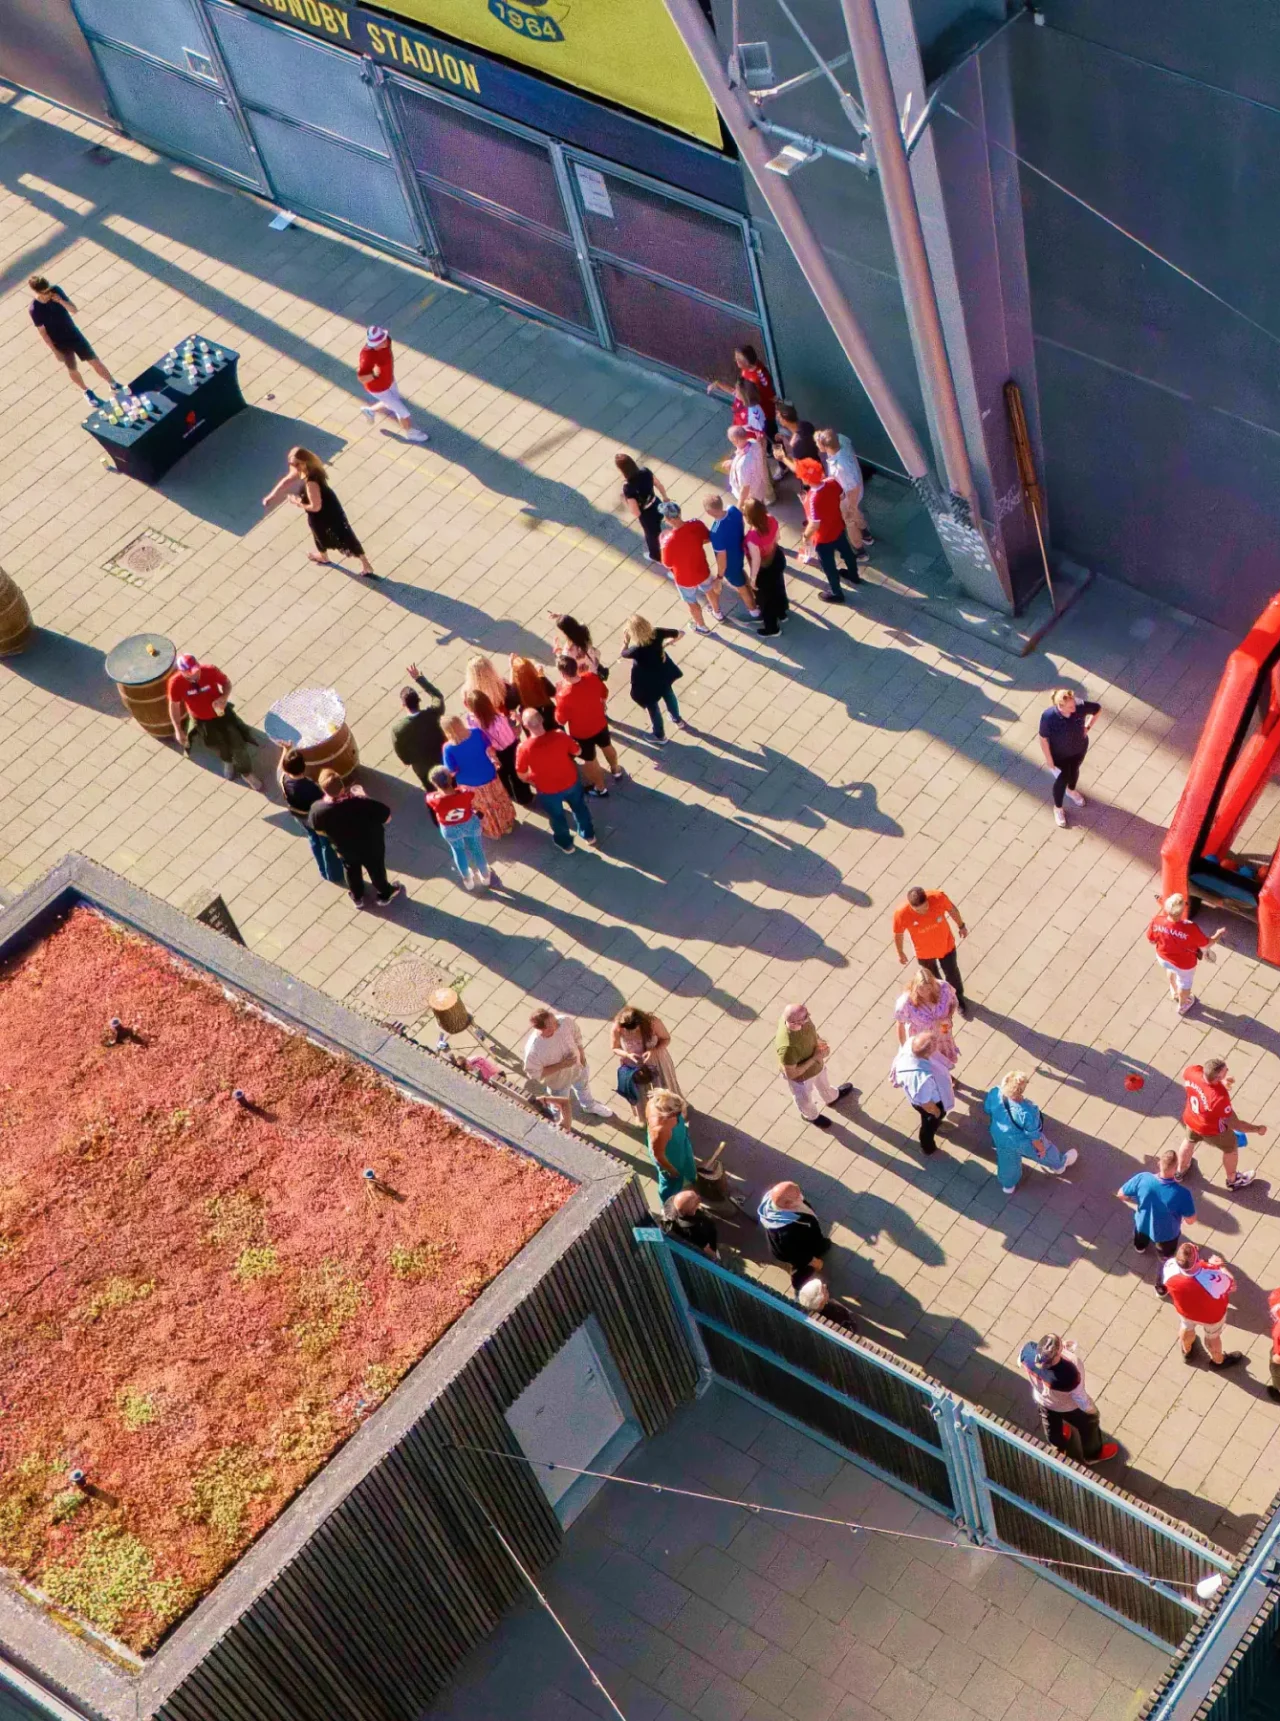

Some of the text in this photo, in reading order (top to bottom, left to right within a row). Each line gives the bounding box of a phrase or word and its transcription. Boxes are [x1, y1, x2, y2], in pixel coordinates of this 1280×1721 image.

[258, 0, 481, 94] NDBY STADION
[495, 2, 556, 39] 1964
